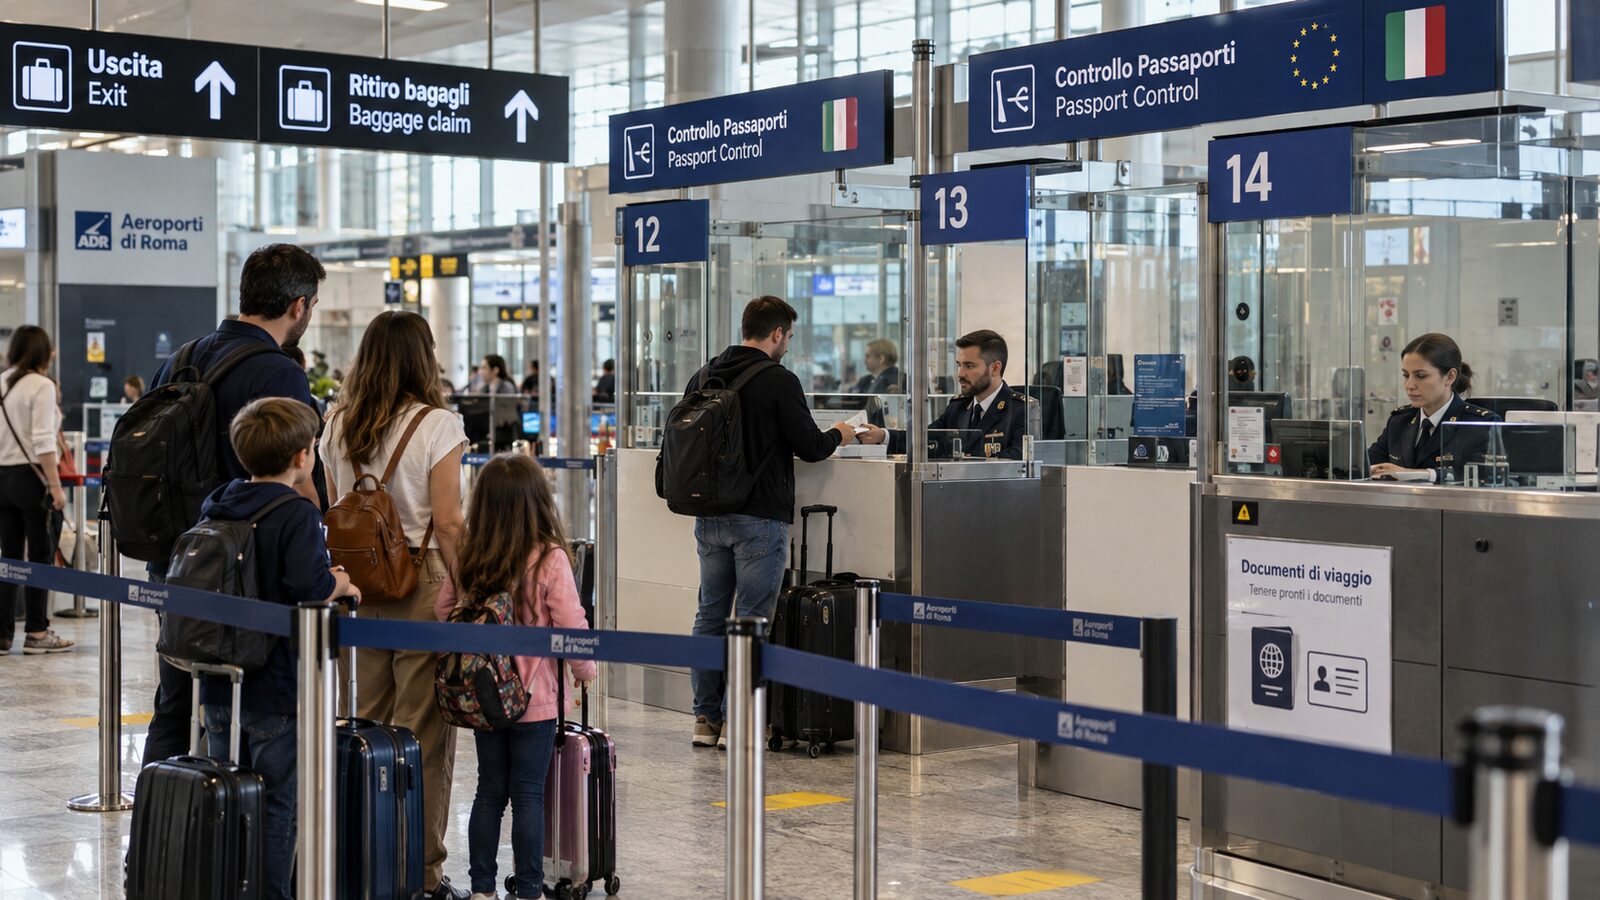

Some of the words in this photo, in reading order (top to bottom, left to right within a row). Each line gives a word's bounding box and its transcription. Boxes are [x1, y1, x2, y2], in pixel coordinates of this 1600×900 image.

[88, 48, 163, 78] Uscita
[1055, 57, 1133, 88] Controllo
[1138, 40, 1236, 76] Passaporti
[88, 81, 128, 107] Exit
[349, 73, 400, 99] Ritiro
[404, 77, 470, 110] bagagli
[1056, 89, 1128, 118] Passport
[1133, 77, 1199, 107] Control
[349, 103, 423, 135] Baggage
[427, 110, 471, 134] claim
[667, 119, 720, 144] Controllo
[723, 109, 788, 136] Passaporti
[668, 146, 717, 169] Passport
[719, 138, 763, 161] Control
[1226, 151, 1272, 203] 14
[934, 185, 968, 230] 13
[120, 213, 204, 235] Aeroporti
[634, 215, 660, 253] 12
[77, 235, 109, 249] ADR
[120, 233, 136, 250] di
[140, 235, 188, 251] Roma
[1241, 559, 1305, 579] Documenti
[1308, 565, 1321, 581] di
[1324, 567, 1372, 588] viaggio
[1249, 583, 1277, 598] Tenere
[1279, 588, 1305, 601] pronti
[1307, 591, 1311, 601] i
[1313, 591, 1363, 607] documenti
[565, 635, 600, 647] Aeroporti
